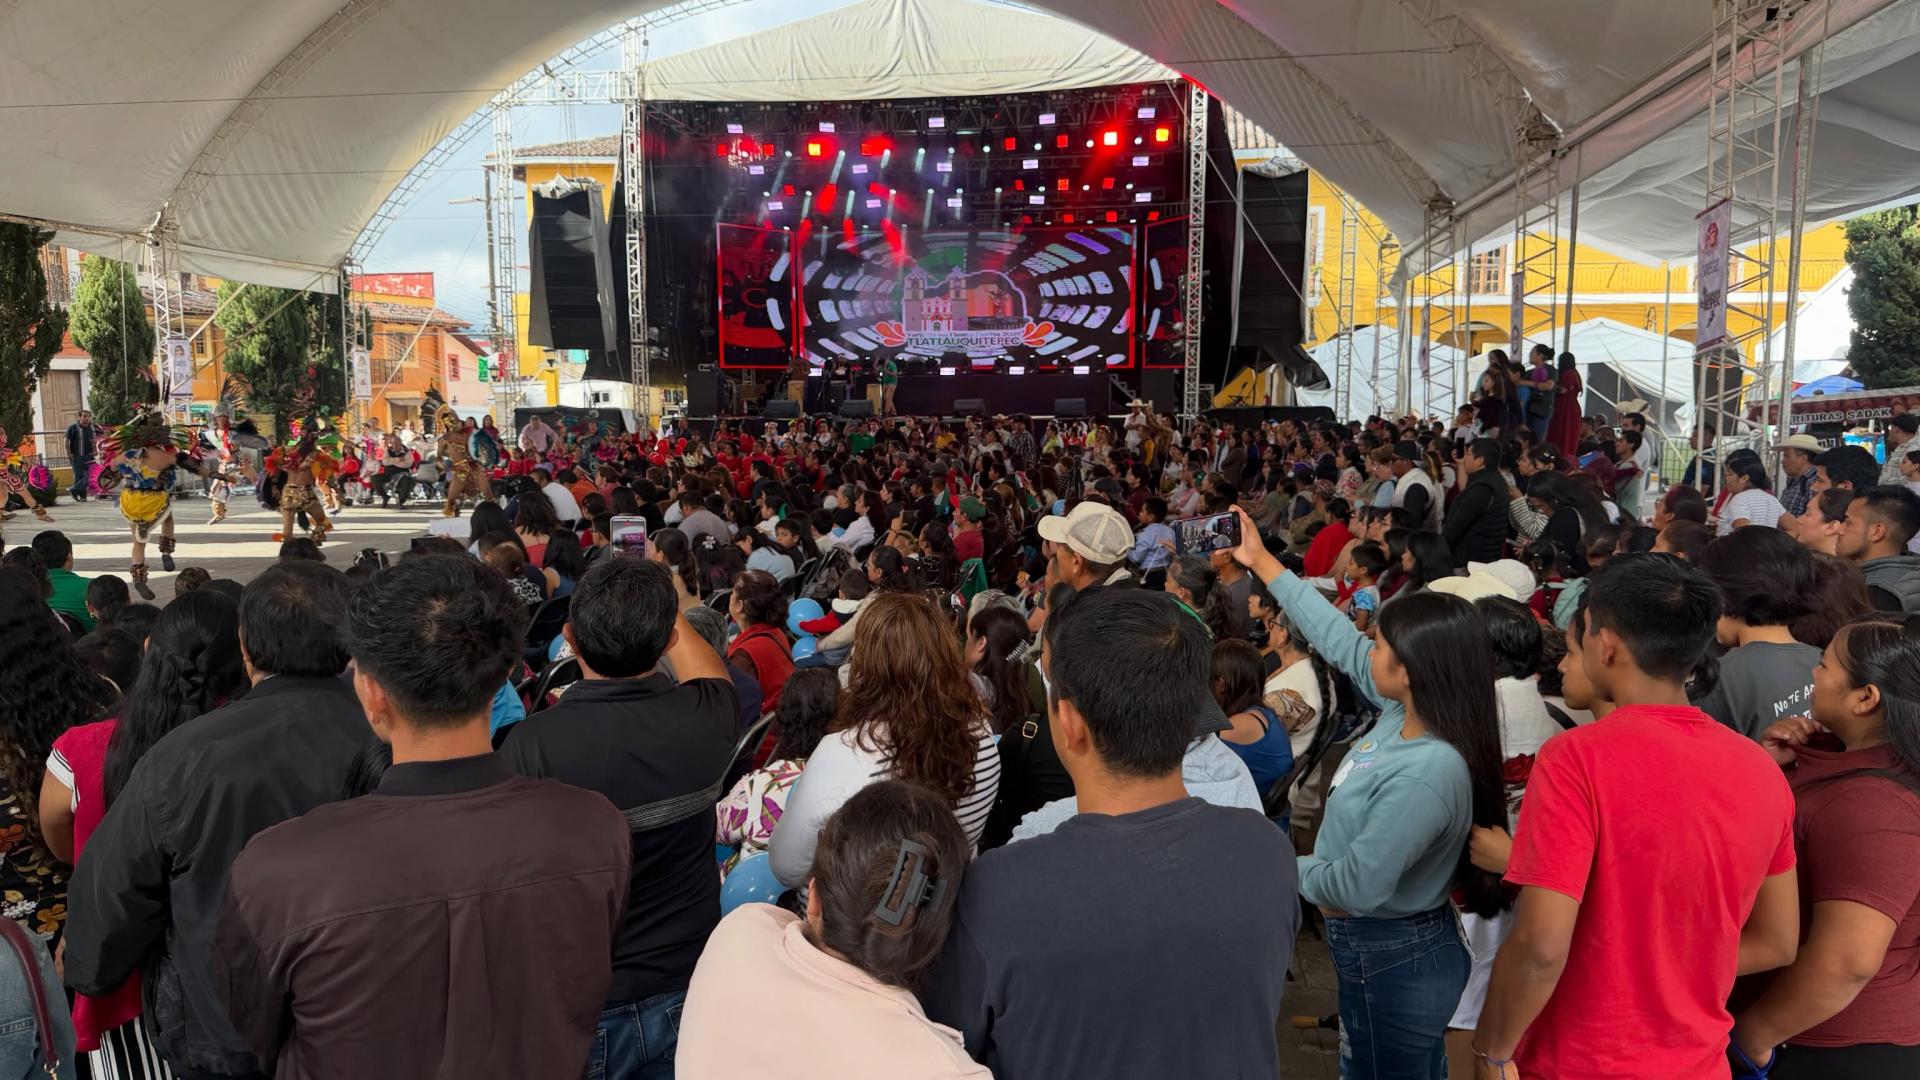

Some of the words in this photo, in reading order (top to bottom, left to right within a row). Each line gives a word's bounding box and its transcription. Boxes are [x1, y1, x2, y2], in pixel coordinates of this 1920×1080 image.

[907, 337, 1021, 346] TLATLAUQUITEPEC
[1791, 411, 1843, 423] RITURAS
[1773, 700, 1788, 718] NO
[1788, 690, 1800, 704] TE
